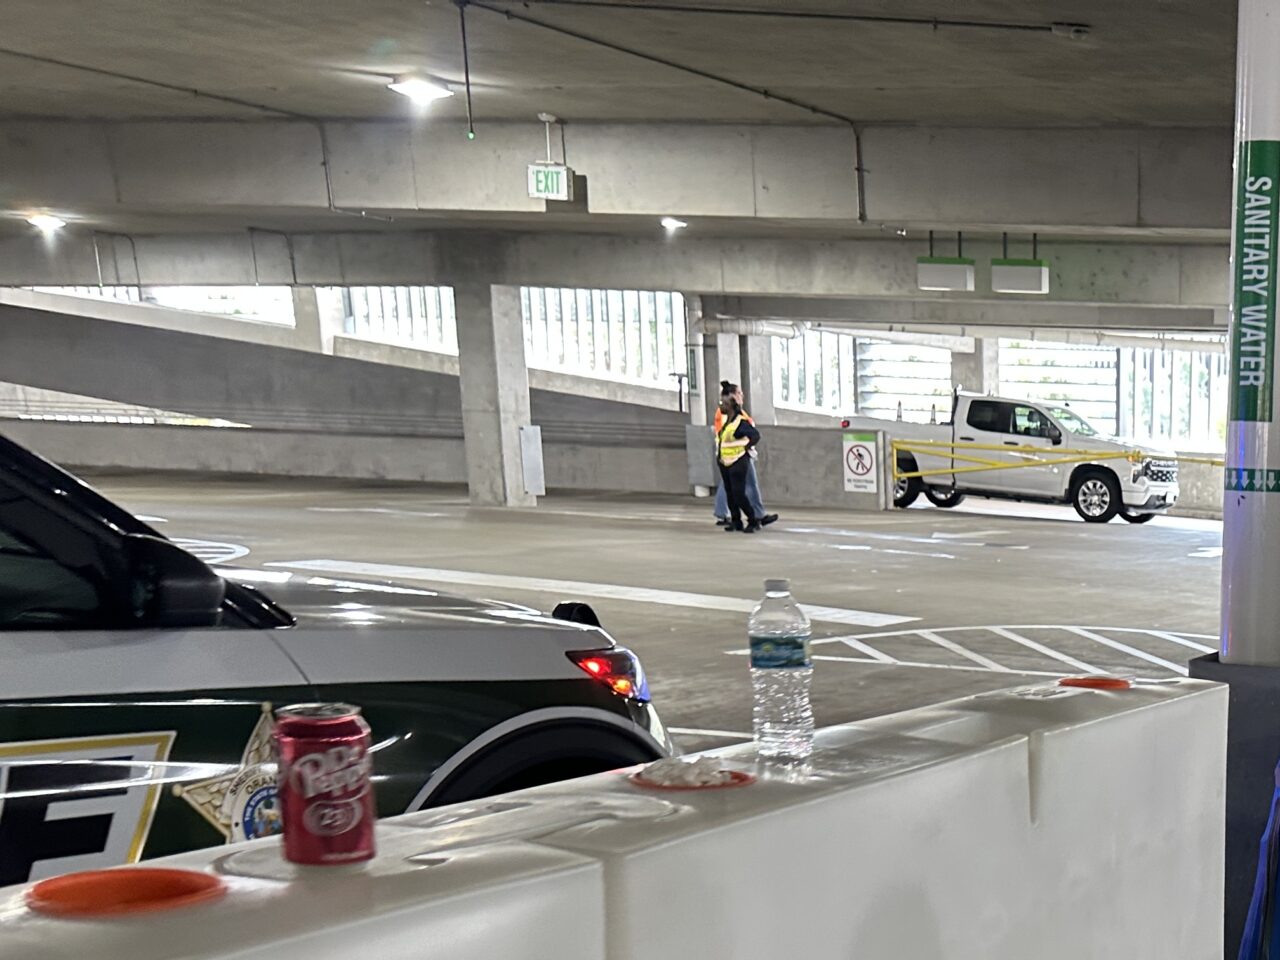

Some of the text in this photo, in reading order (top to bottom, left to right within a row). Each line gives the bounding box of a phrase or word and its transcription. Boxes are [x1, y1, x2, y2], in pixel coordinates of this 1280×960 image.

[535, 170, 561, 194] EXIT
[1239, 176, 1272, 386] SANITARY WATER
